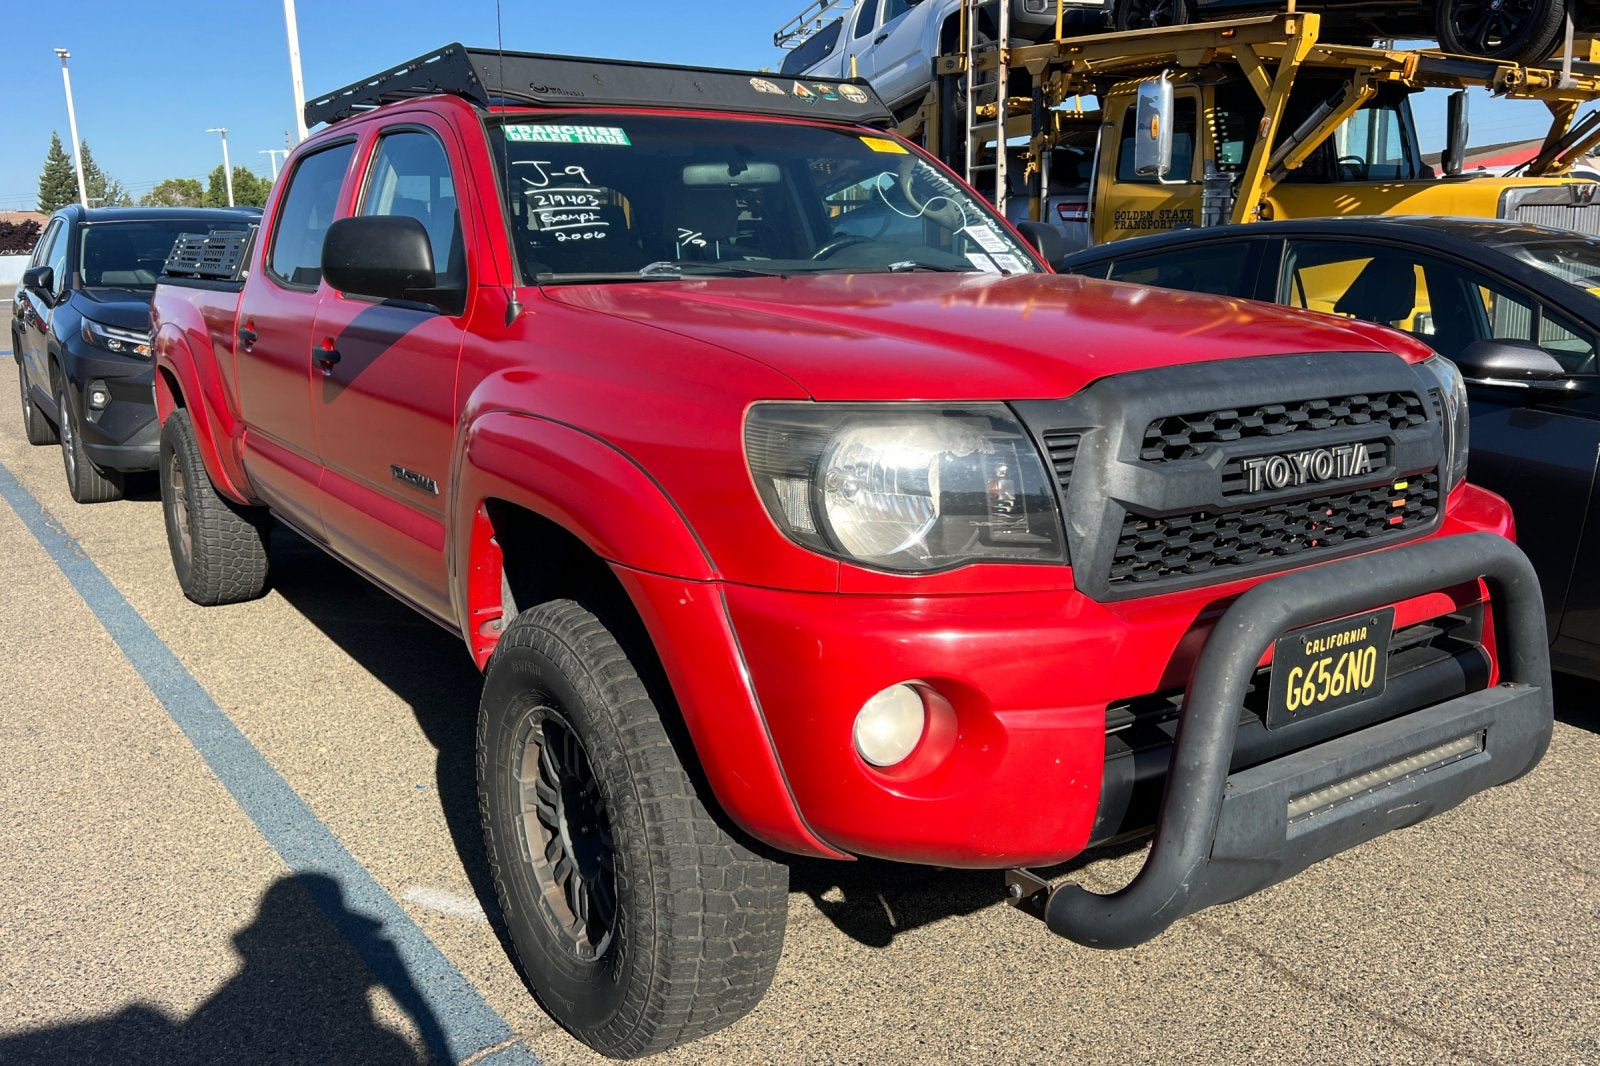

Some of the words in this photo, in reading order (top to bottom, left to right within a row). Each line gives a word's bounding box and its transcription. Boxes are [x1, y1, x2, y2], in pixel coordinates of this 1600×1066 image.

[504, 125, 625, 136] FRANCHISE
[509, 133, 569, 142] DEALER
[575, 134, 627, 145] TRADE
[534, 194, 599, 206] 219403
[1114, 210, 1153, 220] GOLDEN
[1159, 209, 1194, 219] STATE
[555, 231, 606, 241] 2006
[1243, 443, 1372, 493] TOYOTA
[1305, 626, 1367, 655] CALIFORNIA
